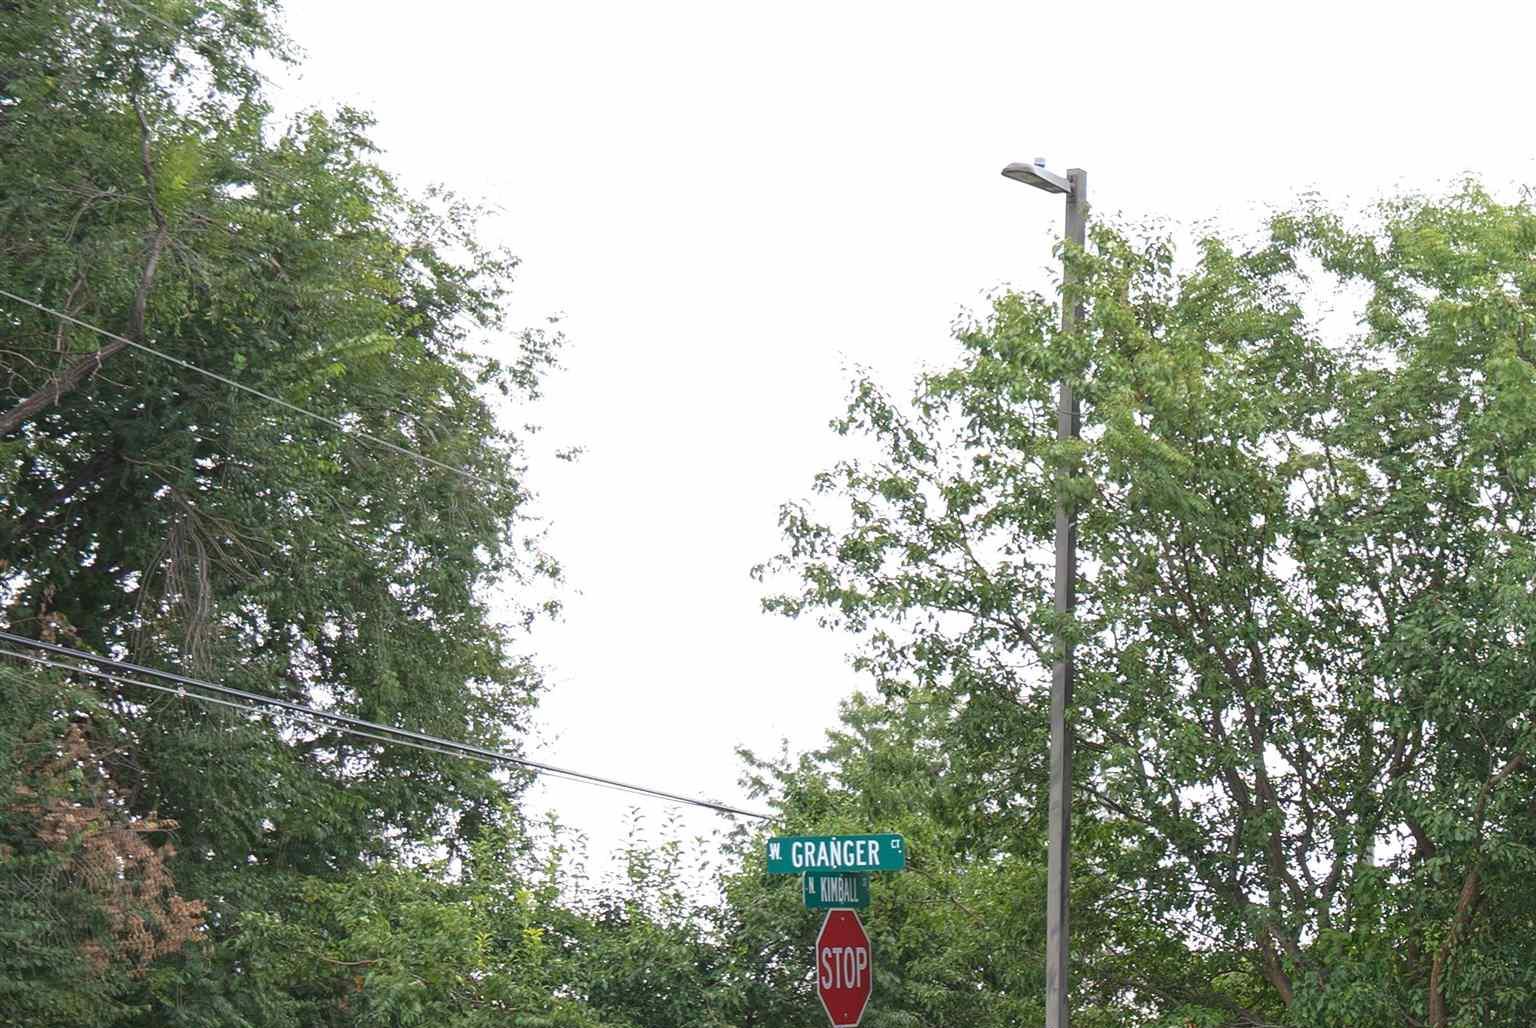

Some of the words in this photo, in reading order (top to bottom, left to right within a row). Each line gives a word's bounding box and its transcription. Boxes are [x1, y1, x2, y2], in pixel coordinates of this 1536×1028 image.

[791, 839, 880, 868] GRANGER
[820, 876, 859, 903] KIMBALL
[821, 946, 867, 989] STOP
